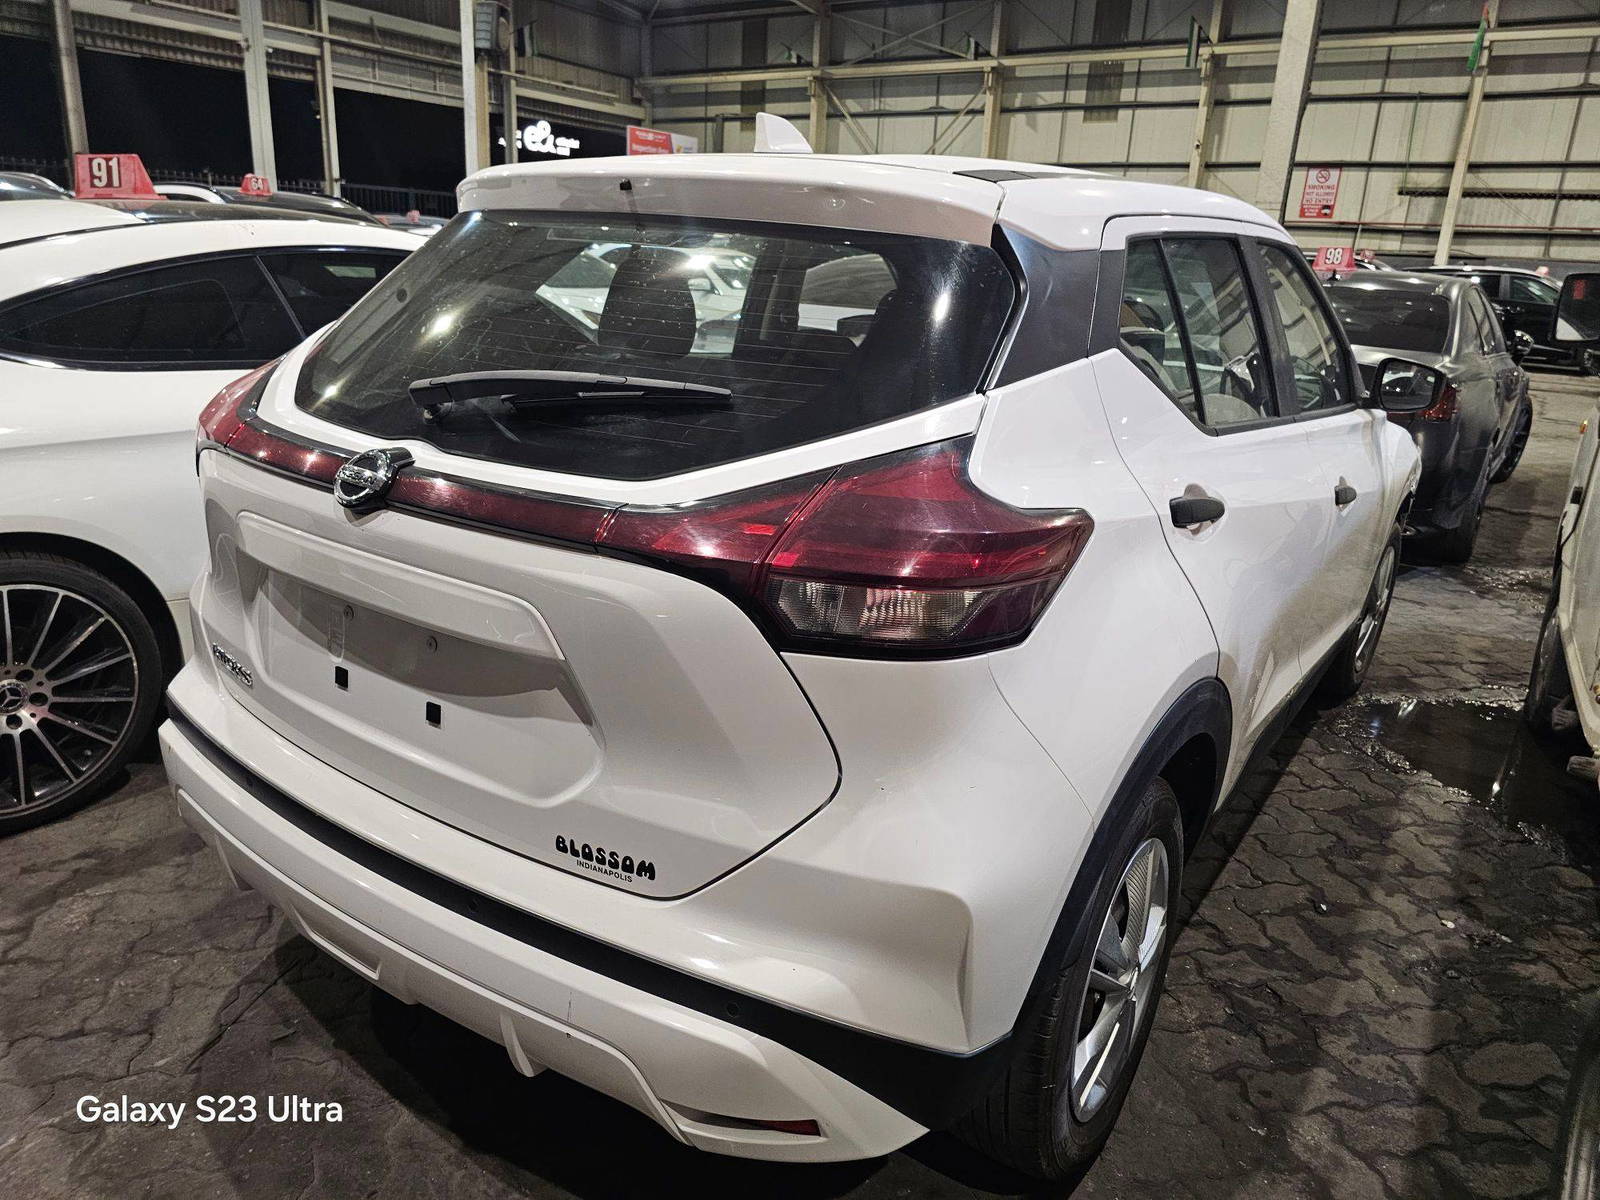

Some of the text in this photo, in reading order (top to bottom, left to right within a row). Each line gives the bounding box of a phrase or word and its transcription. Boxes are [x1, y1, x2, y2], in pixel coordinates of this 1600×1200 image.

[92, 157, 120, 188] 91
[1326, 248, 1343, 264] 98
[576, 859, 633, 883] INDIANAPOLIS
